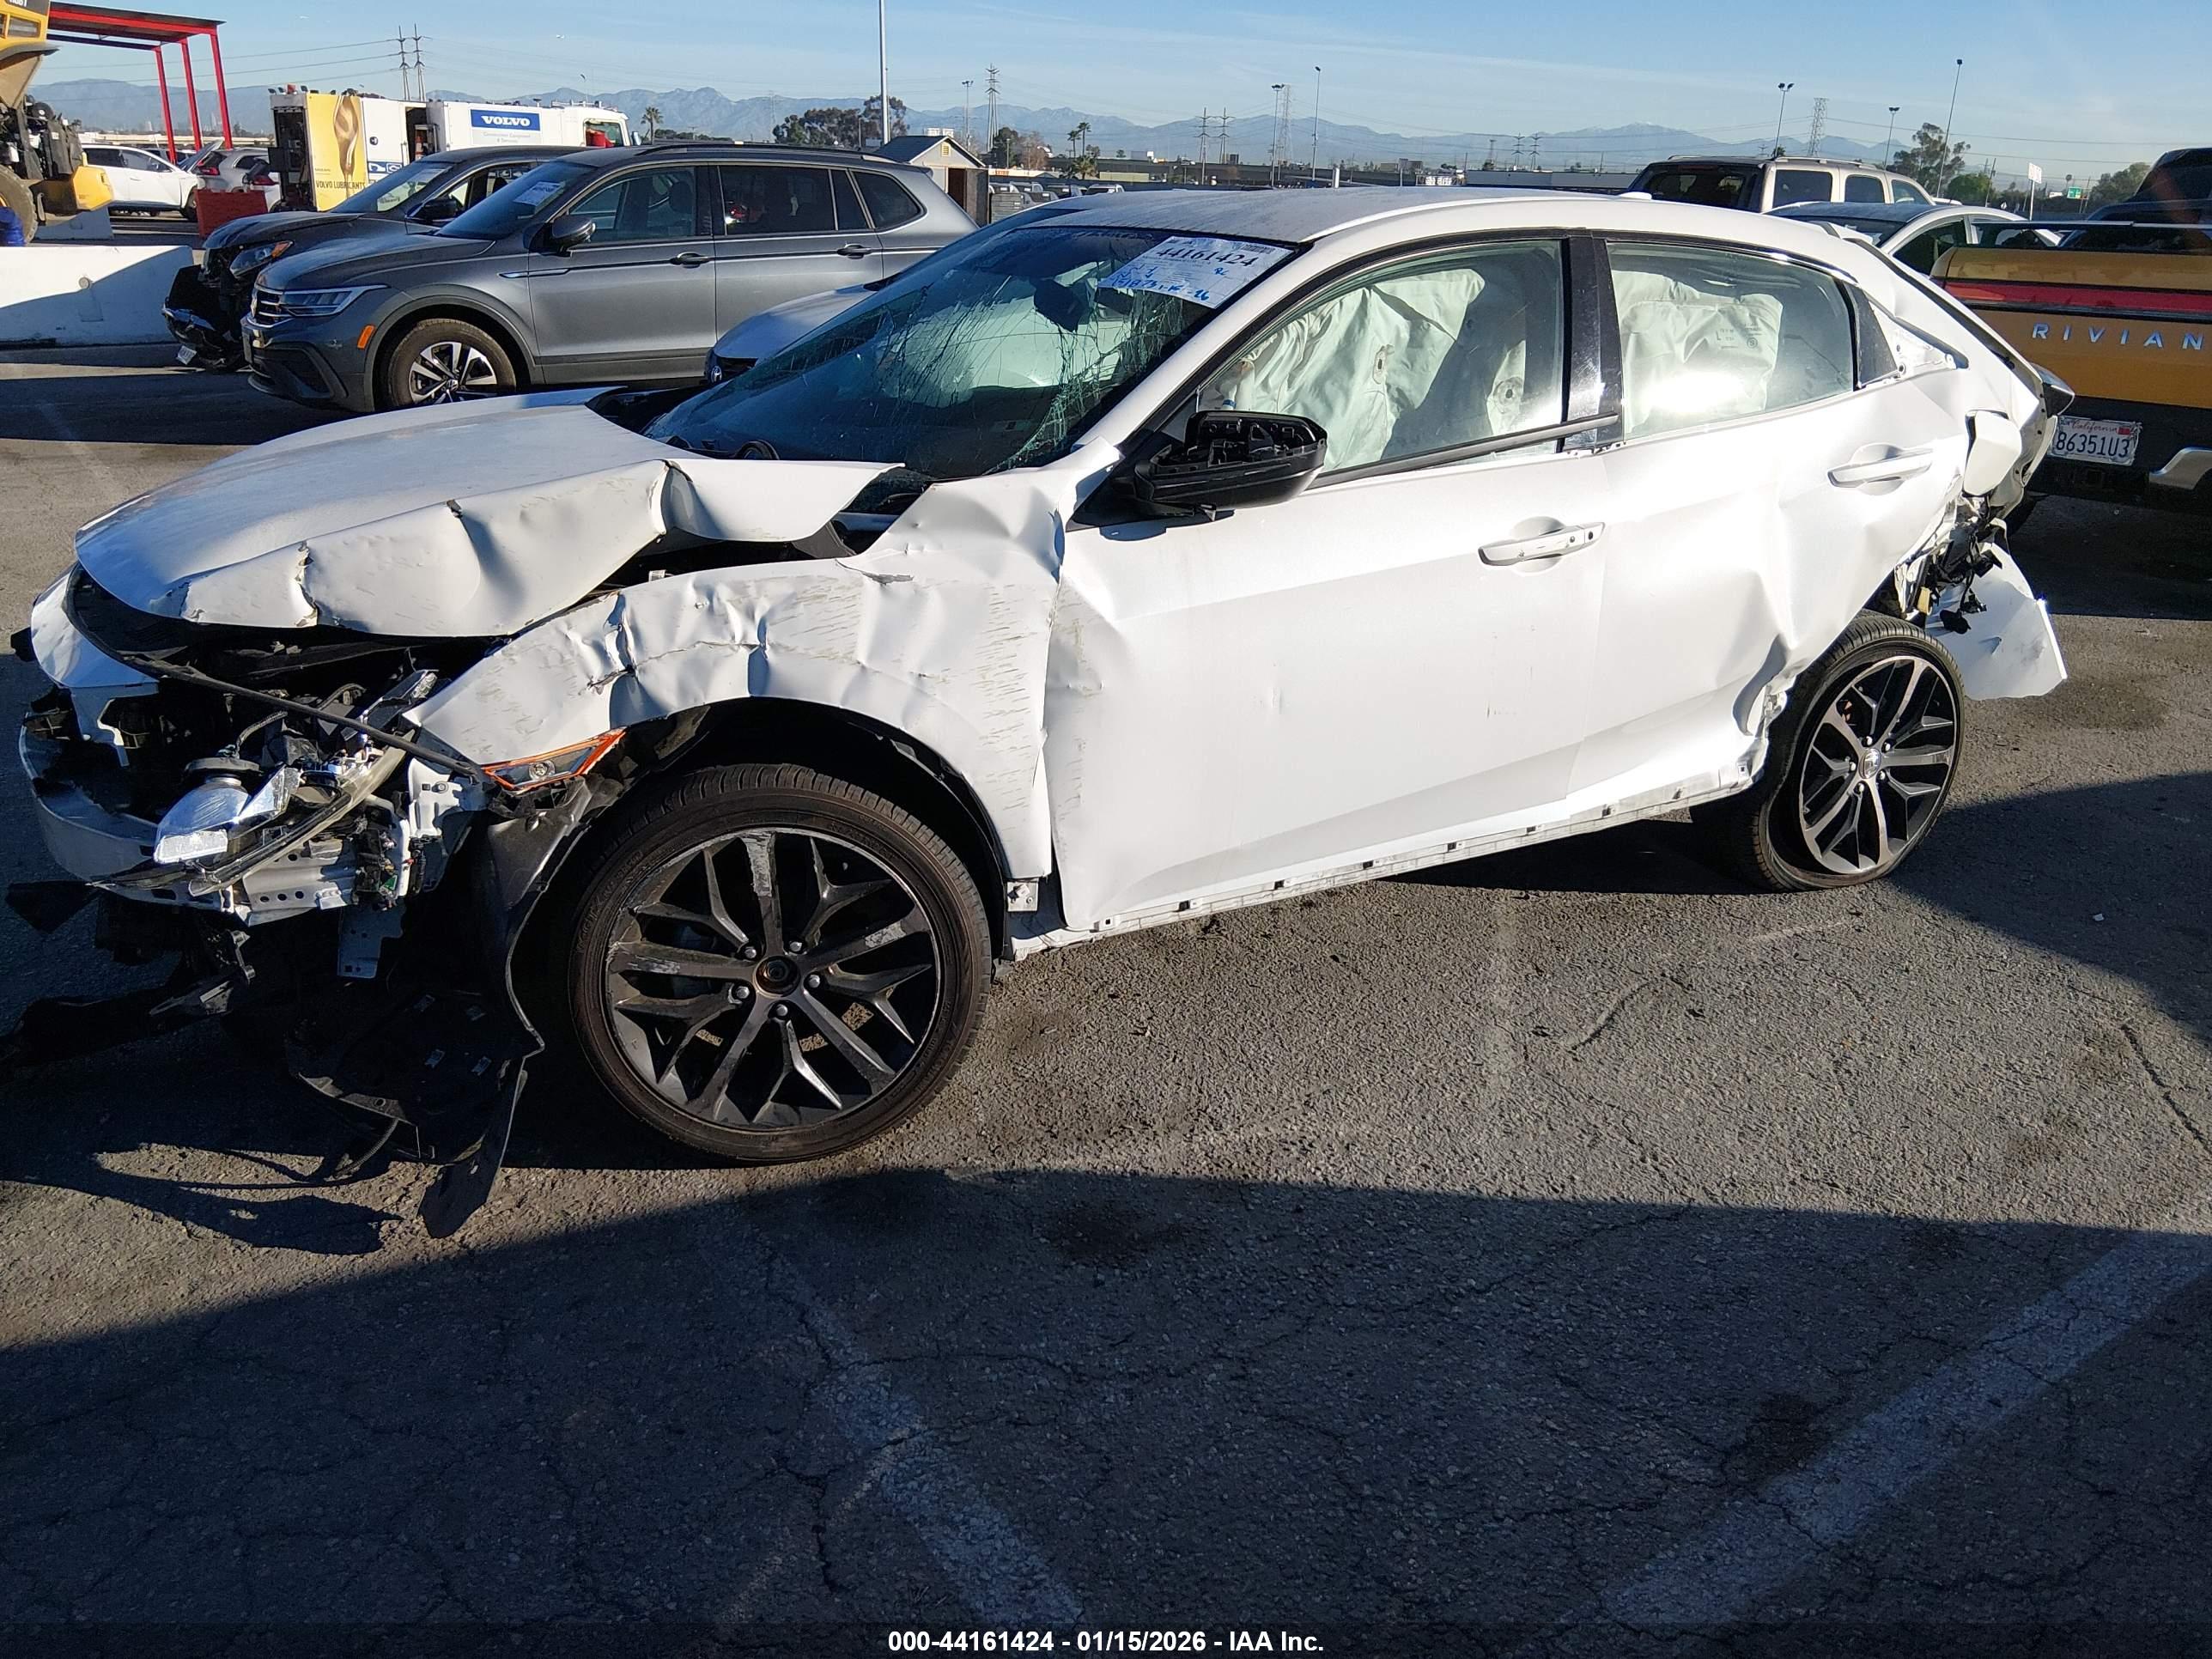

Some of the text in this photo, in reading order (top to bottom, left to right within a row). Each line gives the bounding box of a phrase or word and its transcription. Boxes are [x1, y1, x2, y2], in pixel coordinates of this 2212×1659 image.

[481, 115, 531, 127] VOLVO
[315, 180, 333, 189] VOLVO
[1156, 246, 1260, 267] 44161424
[2032, 322, 2204, 351] RIVIAN
[2072, 418, 2118, 434] California
[2056, 431, 2130, 459] 86351U3
